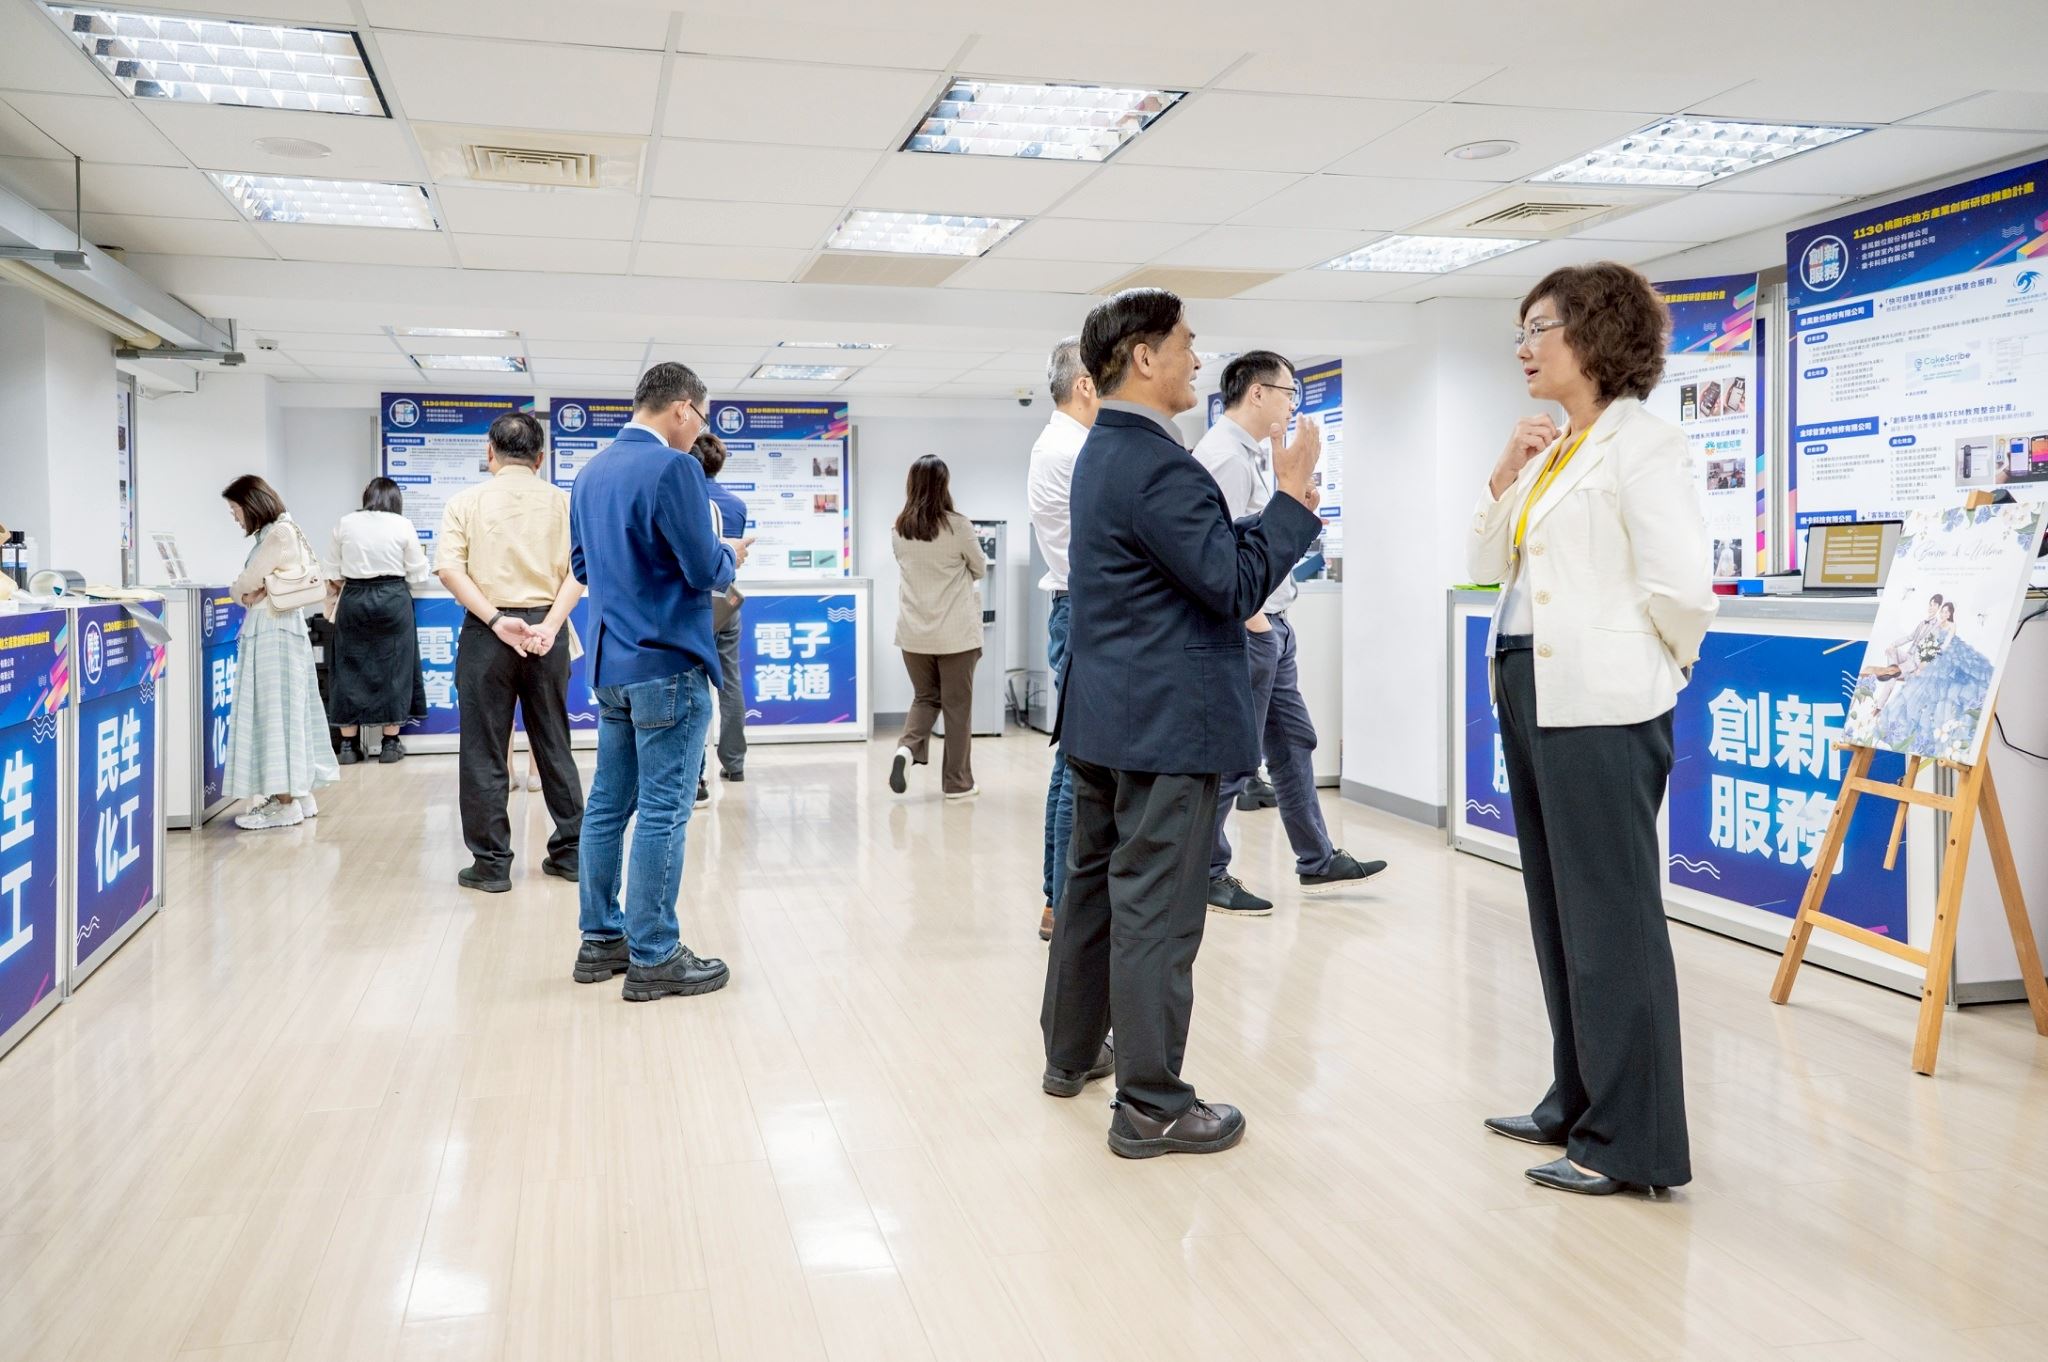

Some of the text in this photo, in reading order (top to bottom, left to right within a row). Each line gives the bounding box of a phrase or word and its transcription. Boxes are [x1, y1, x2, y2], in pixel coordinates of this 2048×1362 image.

[1808, 242, 1840, 265] 創新
[1809, 262, 1840, 285] 服務
[1924, 351, 1971, 366] CakeScribe
[416, 626, 463, 664] 電
[754, 622, 830, 659] 電子
[754, 663, 831, 702] 資通
[96, 708, 140, 801] 民生
[212, 714, 231, 769] 化
[1707, 687, 1846, 783] 創新
[95, 795, 140, 893] 化工
[1709, 774, 1845, 876] 服務
